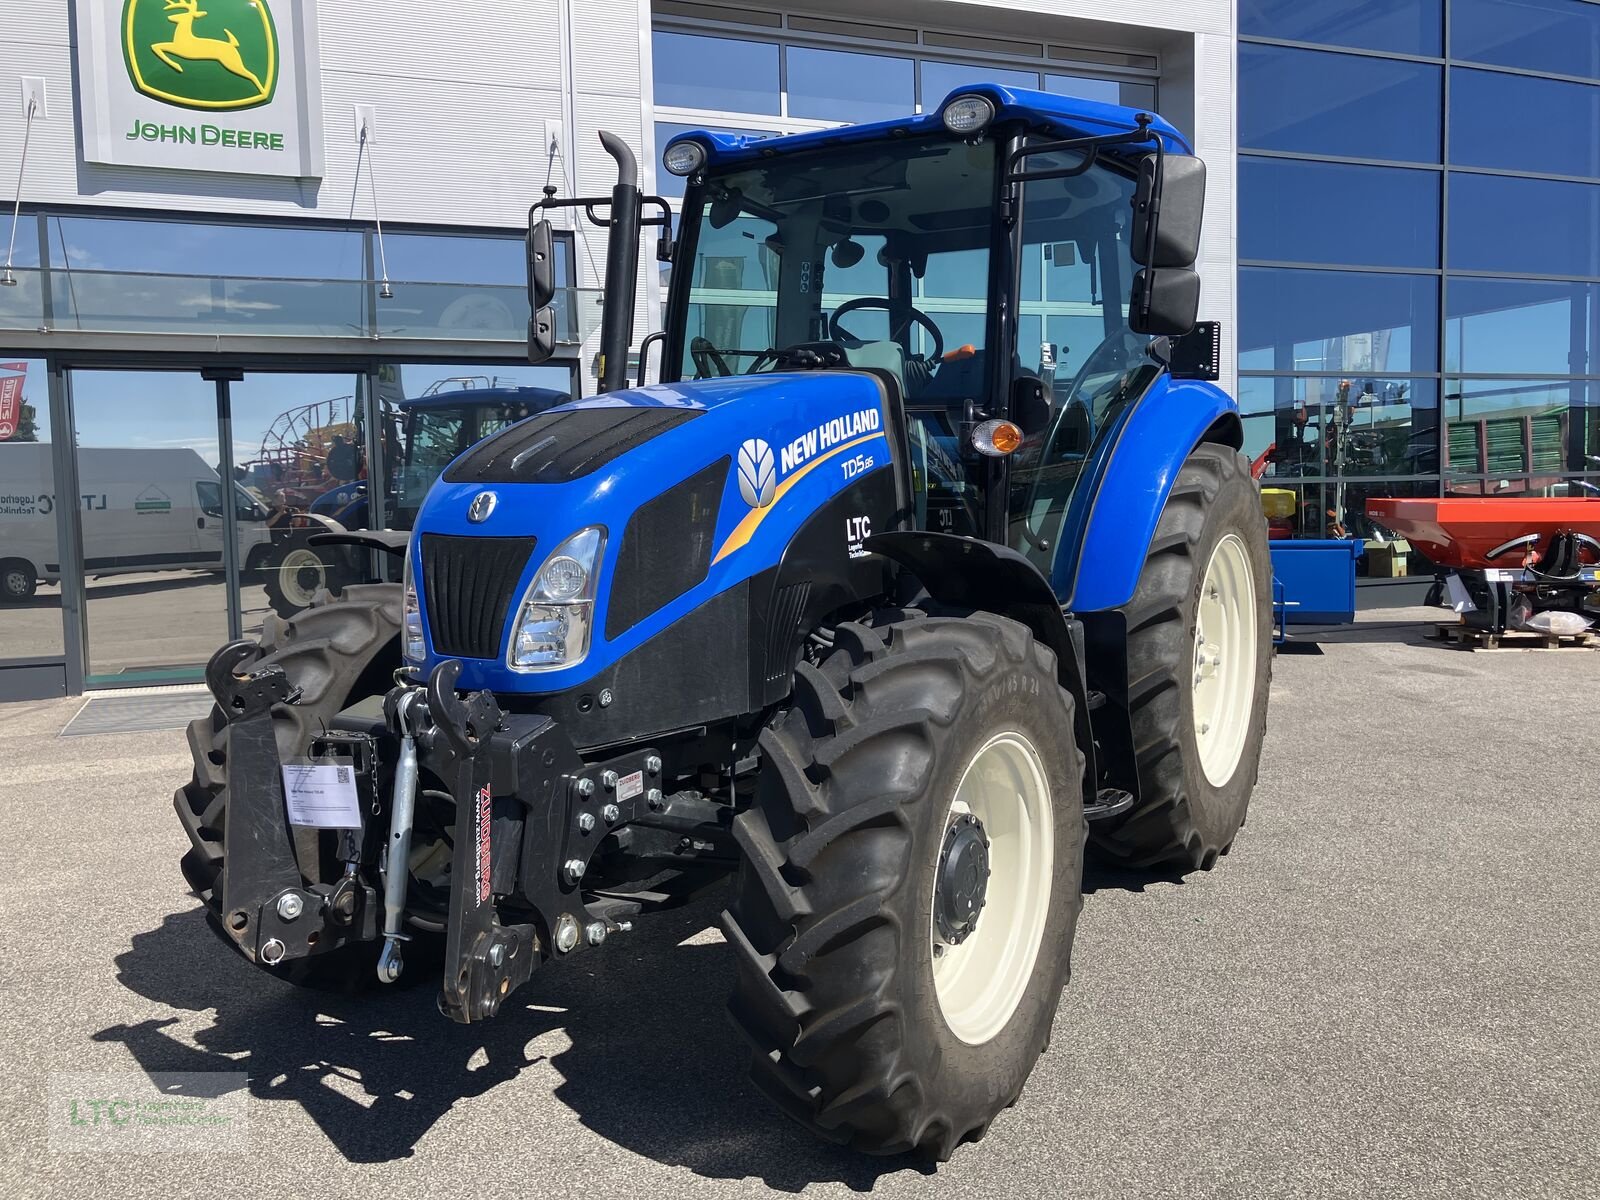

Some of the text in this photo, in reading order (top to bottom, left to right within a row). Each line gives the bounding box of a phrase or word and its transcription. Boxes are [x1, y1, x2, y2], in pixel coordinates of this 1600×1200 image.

[126, 119, 284, 151] JOHN DEERE
[781, 429, 817, 474] NEW
[819, 408, 879, 450] HOLLAND
[846, 515, 871, 541] LTC
[480, 783, 491, 902] ZUIDBERG
